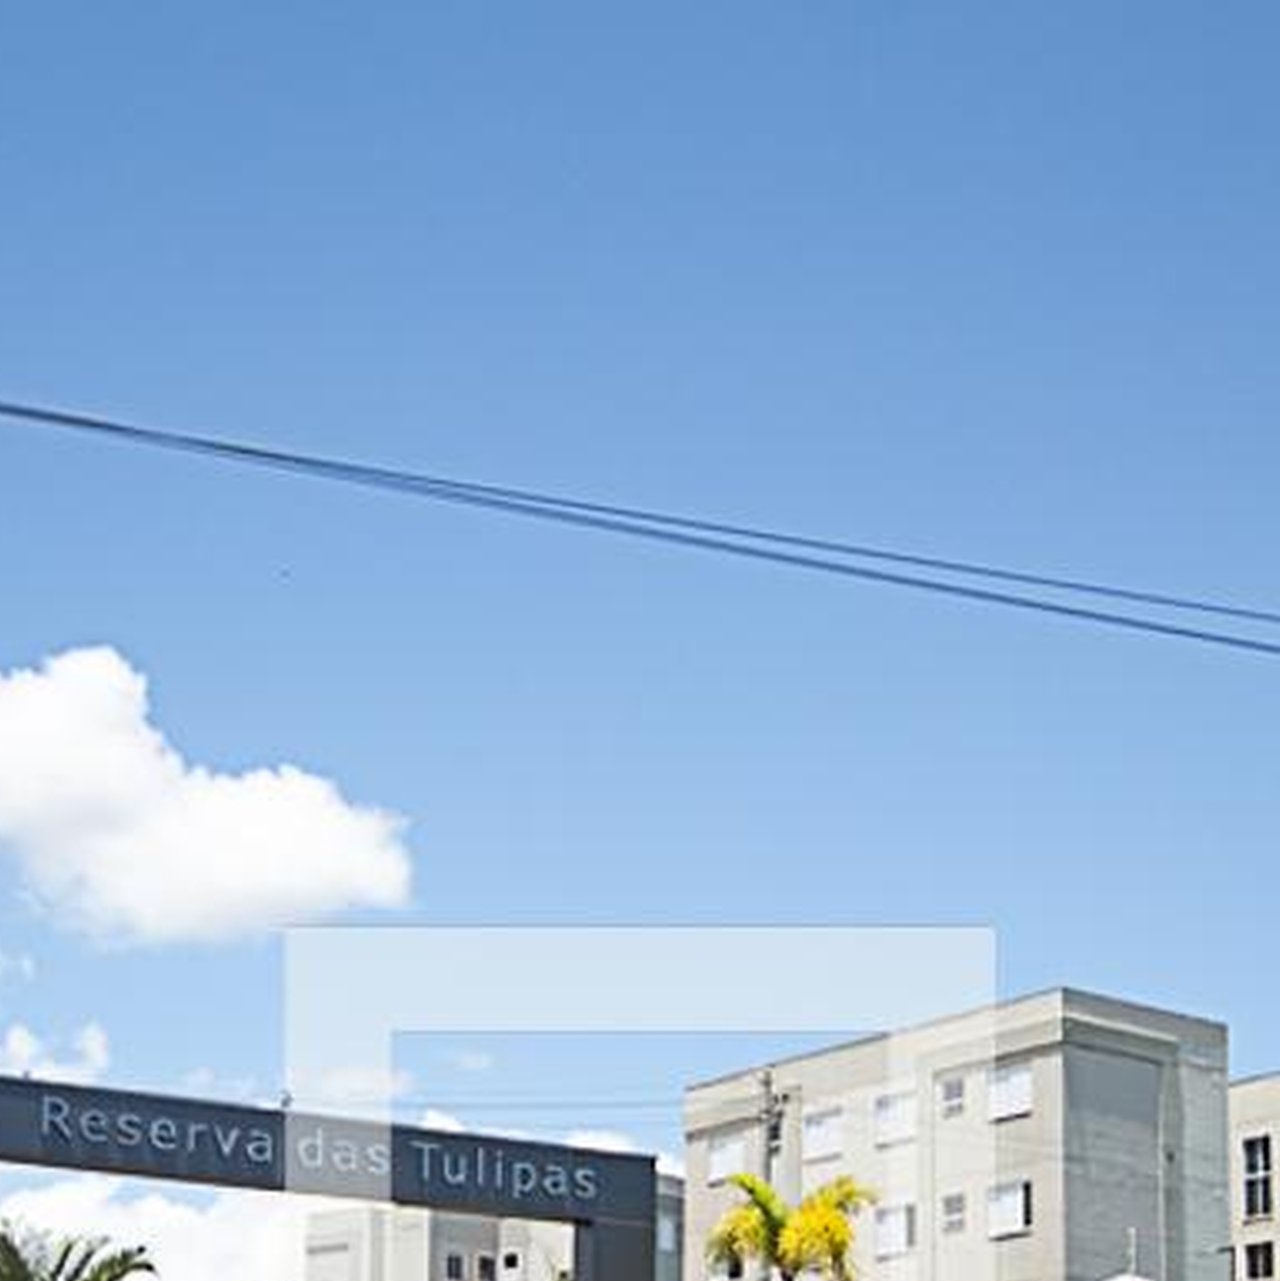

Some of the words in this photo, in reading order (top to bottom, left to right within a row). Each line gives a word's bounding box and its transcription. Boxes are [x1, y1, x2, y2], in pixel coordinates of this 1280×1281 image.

[40, 1094, 274, 1163] Reserva
[297, 1127, 392, 1176] das
[409, 1139, 597, 1199] Tulipas
